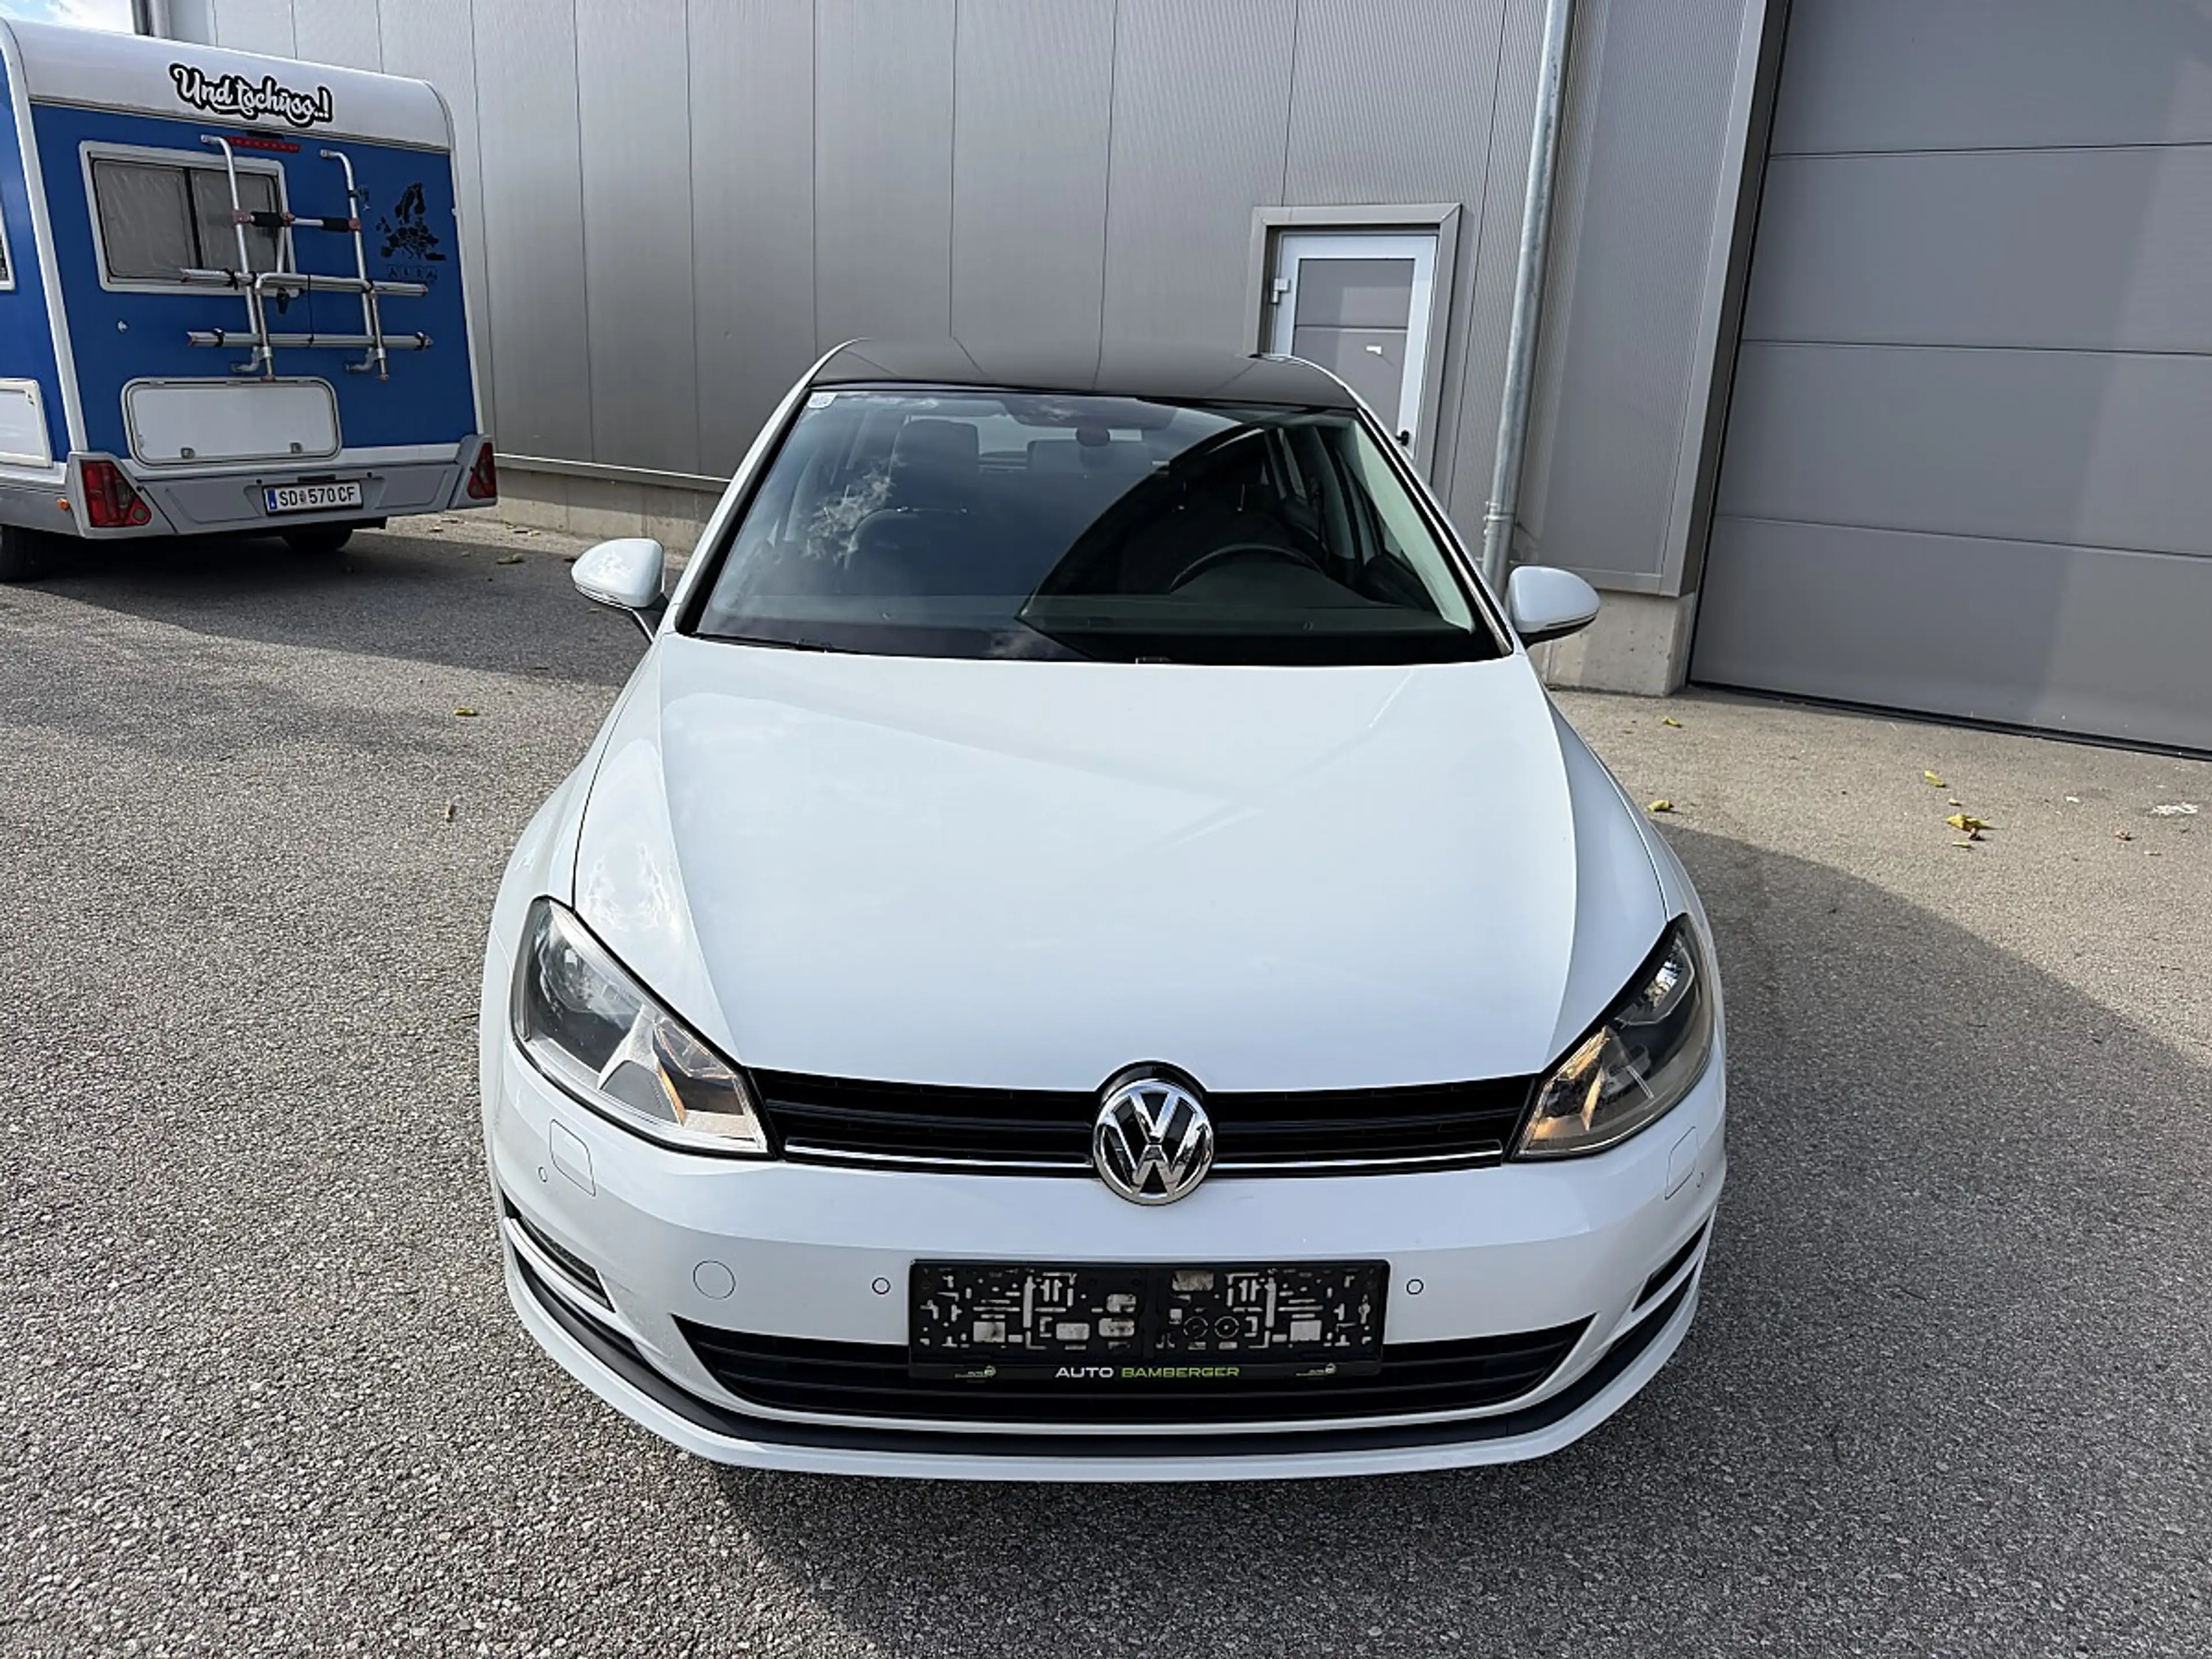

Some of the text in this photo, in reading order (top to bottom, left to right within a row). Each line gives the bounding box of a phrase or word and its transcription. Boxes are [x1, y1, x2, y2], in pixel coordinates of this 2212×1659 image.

[171, 65, 237, 110] Und
[279, 486, 355, 506] SD 570 CF
[1054, 1367, 1240, 1378] AUTO BAMBERGER
